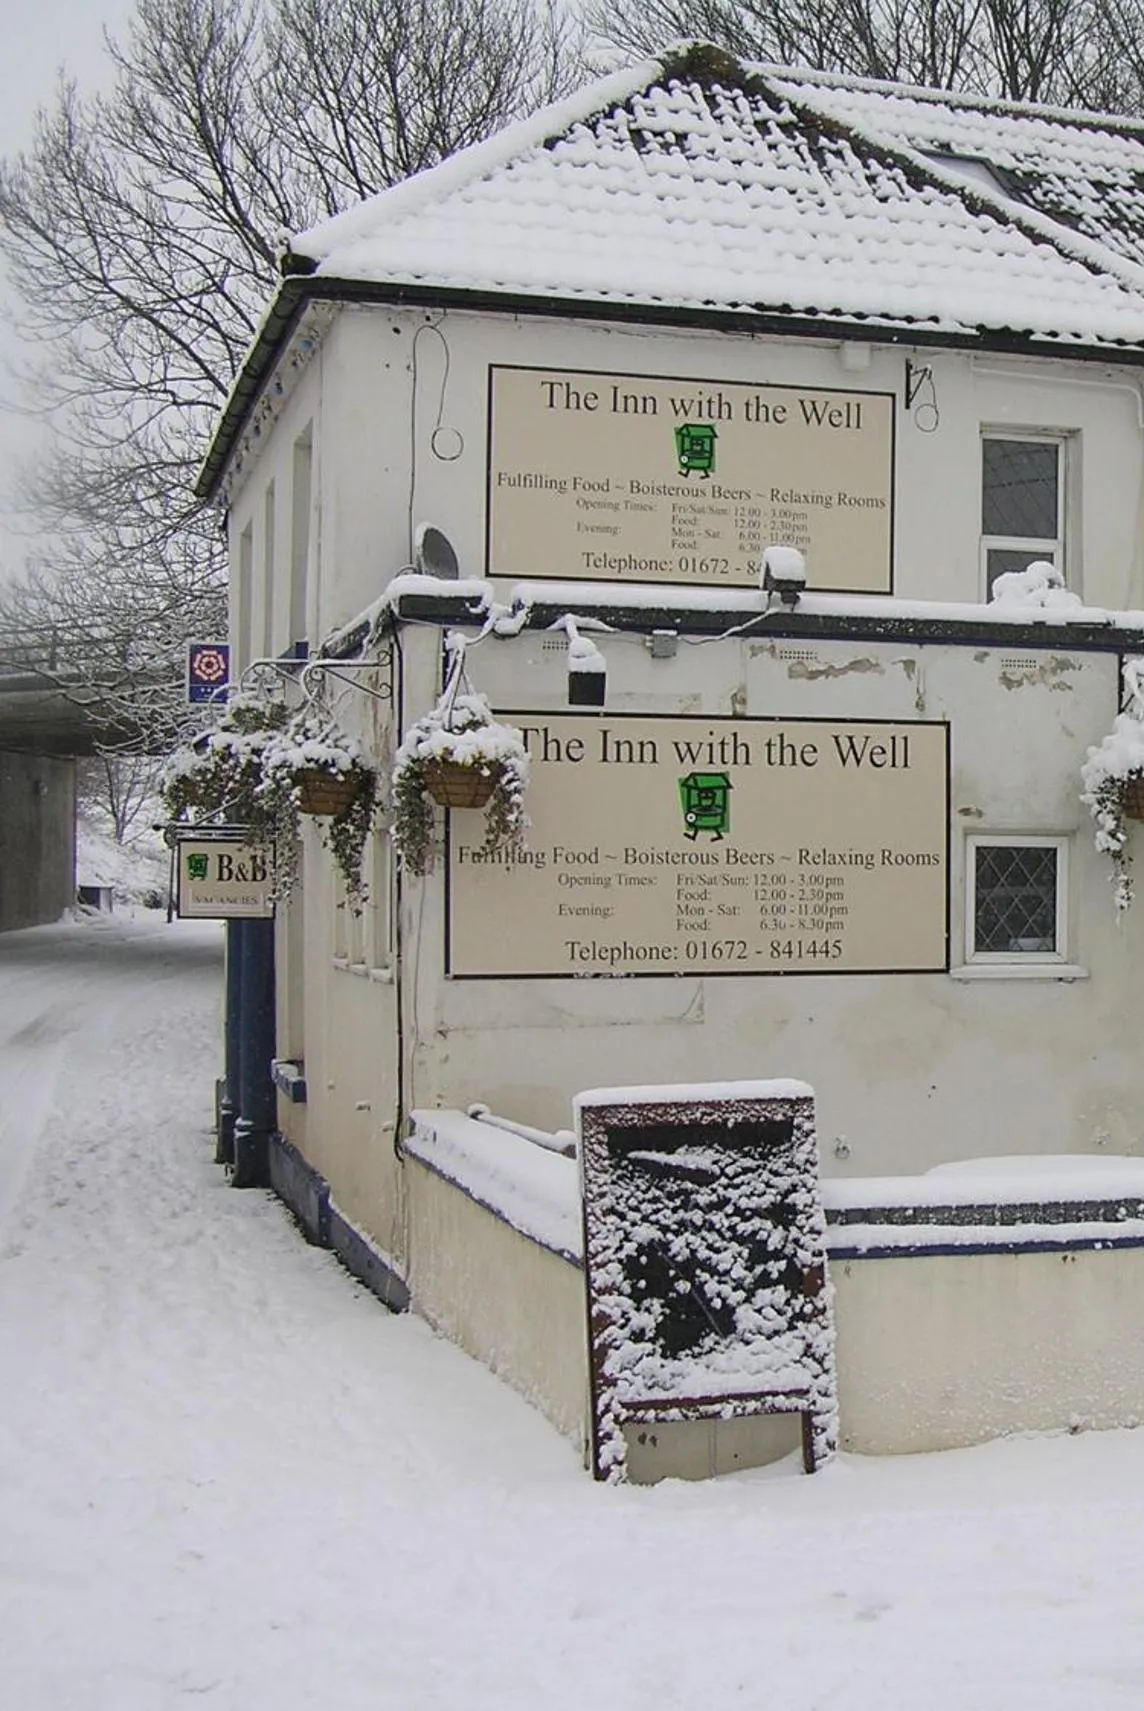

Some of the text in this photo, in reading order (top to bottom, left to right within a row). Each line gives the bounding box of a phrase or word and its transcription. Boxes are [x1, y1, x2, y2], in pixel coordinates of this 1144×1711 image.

[541, 381, 862, 429] The Inn with the Well
[496, 471, 568, 494] Fulfilling
[572, 476, 610, 493] Food
[629, 480, 707, 498] Boisterous
[711, 484, 752, 500] Beers
[770, 487, 833, 509] Relaxing
[837, 491, 887, 509] Rooms
[576, 499, 620, 513] Opening
[576, 521, 622, 537] Evening:
[582, 552, 674, 573] Telephone:
[678, 557, 729, 574] 01672
[519, 727, 912, 769] The Inn with the Well
[216, 853, 267, 882] B&B
[552, 846, 599, 865] Food
[623, 847, 719, 866] Boisterous
[725, 848, 775, 866] Beers
[798, 848, 875, 869] Relaxing
[880, 848, 940, 866] Rooms
[557, 873, 612, 889] Opening
[616, 873, 658, 886] Times:
[754, 873, 787, 886] 12.00
[798, 873, 845, 889] 3.00pm
[676, 887, 712, 901] Food:
[754, 888, 787, 901] 12.00
[798, 888, 844, 903] 2.30pm
[557, 904, 615, 919] Evening:
[676, 903, 705, 916] Mon
[760, 904, 787, 916] 6.00
[798, 903, 849, 919] 11.00pm
[676, 917, 712, 931] Food:
[760, 918, 787, 930] 6.30
[798, 918, 844, 933] 8.30pm
[565, 940, 678, 964] Telephone:
[686, 940, 748, 960] 01672
[769, 939, 843, 960] 841445
